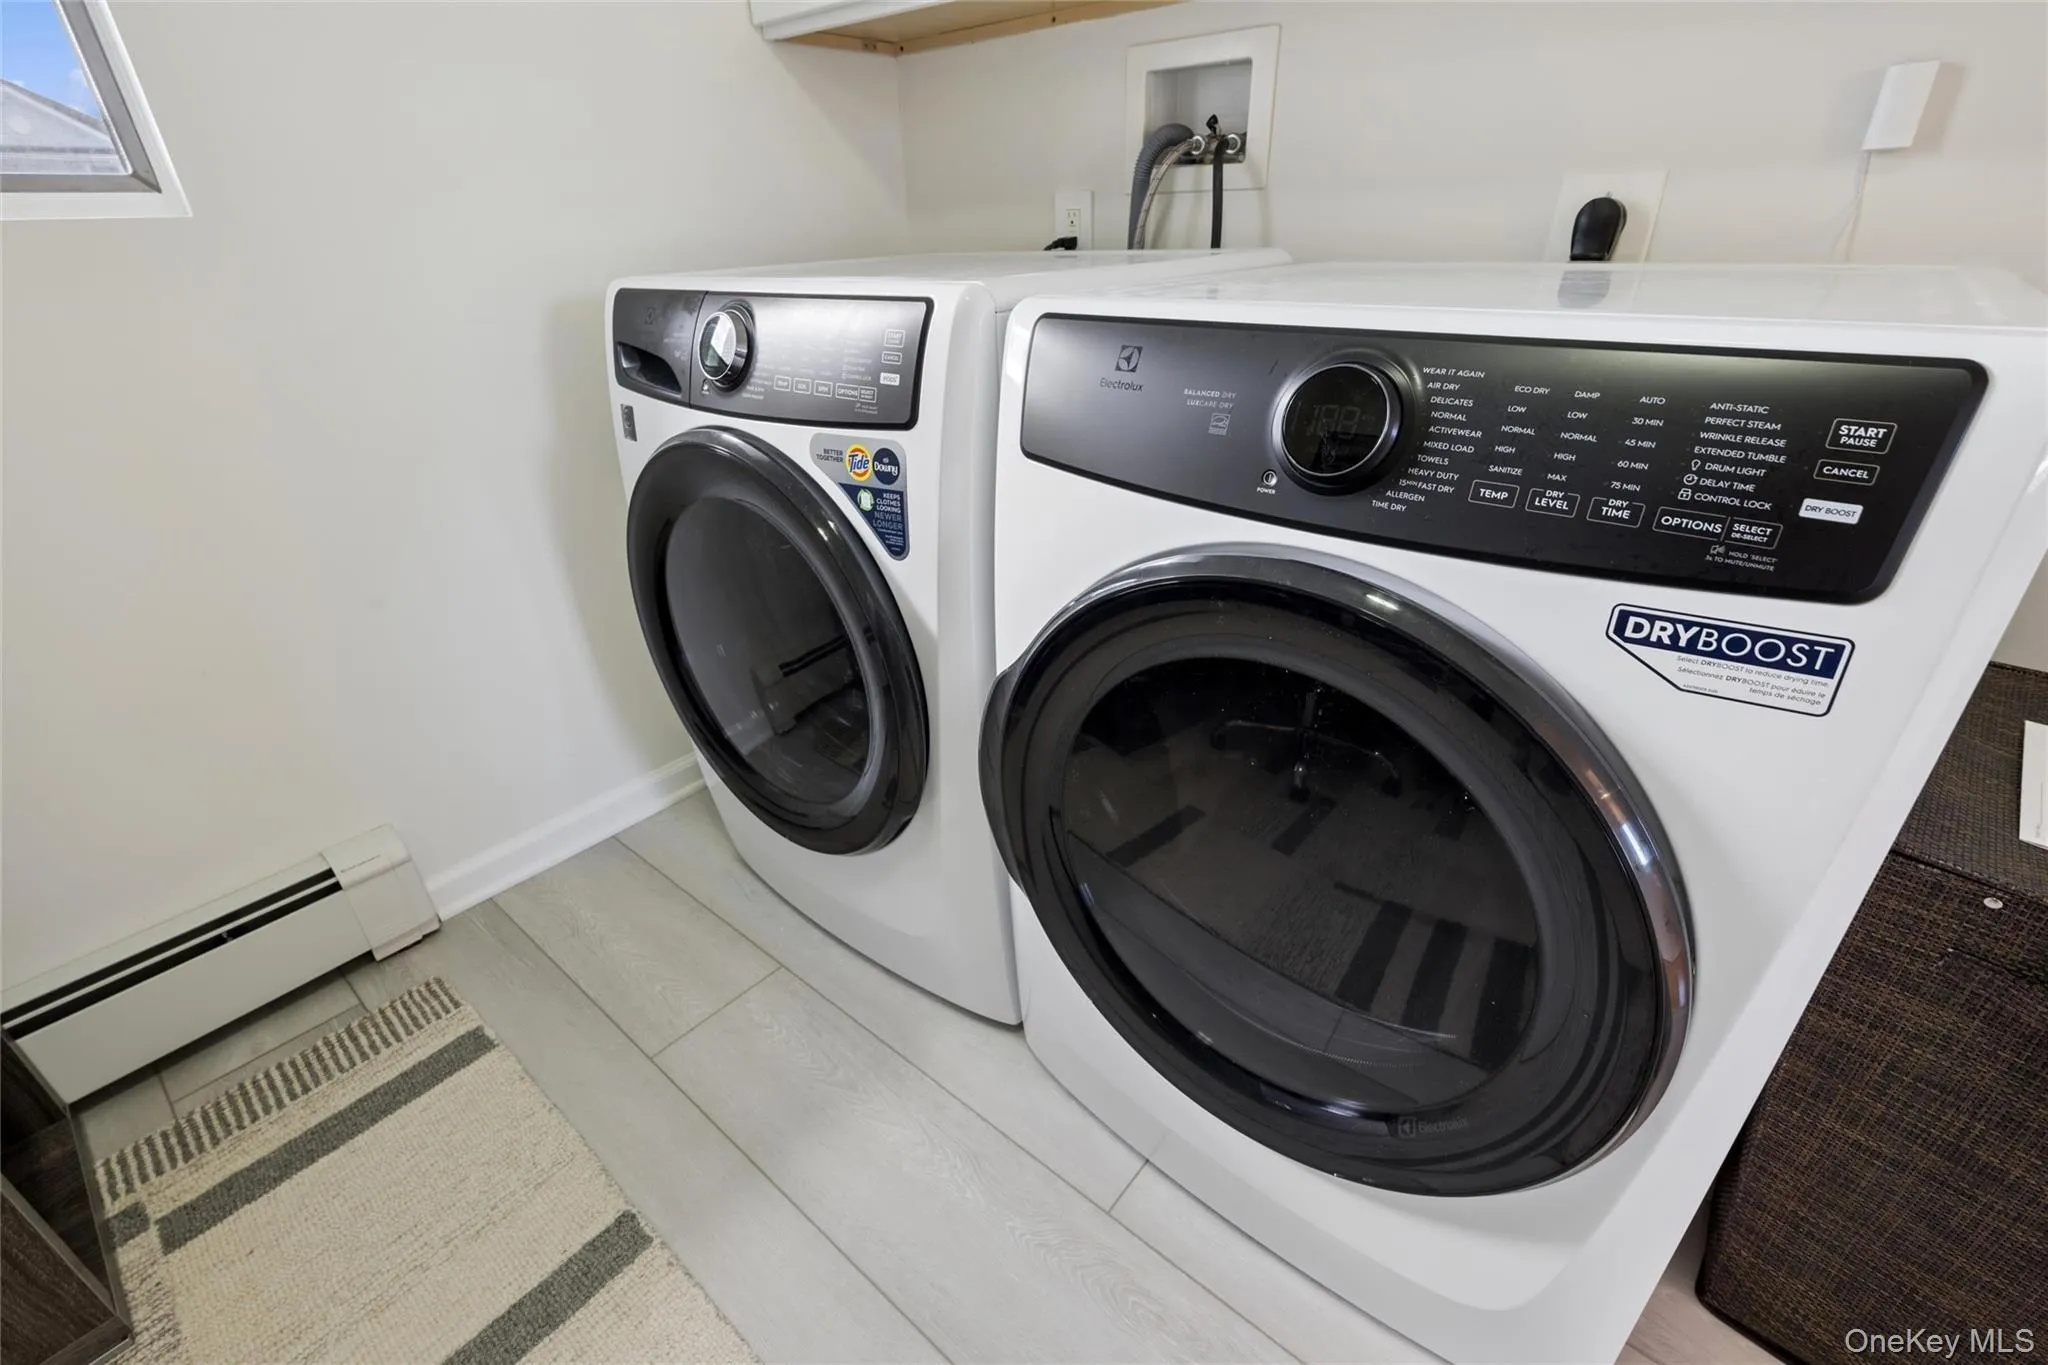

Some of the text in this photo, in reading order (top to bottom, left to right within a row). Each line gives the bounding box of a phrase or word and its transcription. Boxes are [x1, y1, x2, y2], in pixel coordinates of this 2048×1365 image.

[1423, 367, 1446, 376] WEAR
[1457, 370, 1485, 378] AGAIN
[1099, 377, 1144, 392] Electrolux
[1427, 382, 1460, 391] AIR DRY
[1514, 385, 1550, 395] ECO DRY
[1183, 388, 1237, 399] BALANCED DRY
[1574, 390, 1600, 400] DAMP
[1187, 399, 1234, 409] LUXCARE DRY
[1430, 396, 1474, 407] DELICATES
[1640, 396, 1666, 405] AUTO
[1507, 405, 1527, 413] LOW
[1710, 402, 1770, 414] ANTI-STATIC
[1431, 411, 1467, 421] NORMAL
[1567, 411, 1588, 420] LOW
[1632, 416, 1664, 427] 30 MIN
[1704, 416, 1781, 431] PERFECT STEAM
[1428, 426, 1482, 438] ACTIVEWEAR
[1501, 425, 1536, 436] NORMAL
[1838, 425, 1887, 440] START
[1560, 432, 1597, 443] NORMAL
[1700, 431, 1787, 448] WRINKLE RELEASE
[1840, 436, 1878, 448] PAUSE
[1423, 441, 1475, 453] MIXED LOAD
[1624, 438, 1656, 449] 45 MIN
[823, 448, 843, 456] BETTER
[1494, 445, 1516, 454] HIGH
[1694, 446, 1787, 464] EXTENDED TUMBLE
[816, 454, 844, 463] TOGETHER
[1417, 455, 1449, 465] TOWELS
[1553, 452, 1576, 462] HIGH
[848, 453, 870, 473] Tide
[874, 461, 899, 476] Downy
[1617, 460, 1649, 470] 60 MIN
[1408, 467, 1459, 481] HEAVY DUTY
[1488, 464, 1523, 476] SANITIZE
[1704, 462, 1766, 478] DRUM LIGHT
[1823, 466, 1869, 479] CANCEL
[1547, 473, 1567, 482] MAX
[1256, 486, 1276, 495] POWER
[1417, 481, 1437, 491] FAST
[1437, 485, 1455, 494] DRY
[1610, 481, 1641, 492] 75 MIN
[1699, 477, 1756, 493] DELAY TIME
[883, 492, 901, 500] KEEPS
[1385, 490, 1425, 502] ALLERGEN
[1479, 488, 1508, 500] TEMP
[1545, 490, 1565, 499] DRY
[876, 498, 901, 506] CLOTHES
[1372, 500, 1407, 512] TIME DRY
[1535, 498, 1569, 511] LEVEL
[1608, 499, 1629, 508] DRY
[1694, 492, 1773, 511] CONTROL LOCK
[876, 505, 901, 513] LOOKING
[1601, 507, 1631, 519] TIME
[1804, 504, 1857, 518] DRY BOOST
[874, 511, 902, 522] NEWER
[873, 520, 903, 530] LONGER
[1660, 515, 1722, 534] OPTIONS
[1732, 523, 1773, 536] SELECT
[1730, 533, 1768, 543] DE-SELECT
[1728, 551, 1749, 559] HOLD
[1724, 558, 1775, 572] MUTE/UNMUTE
[1624, 615, 1835, 670] DRYBOOST
[1677, 655, 1699, 665] Select
[1700, 659, 1744, 673] DRYBOOST
[1745, 665, 1753, 674] to
[1755, 668, 1783, 679] reduce
[1784, 672, 1809, 685] drying
[1725, 675, 1770, 688] DRYBOOST
